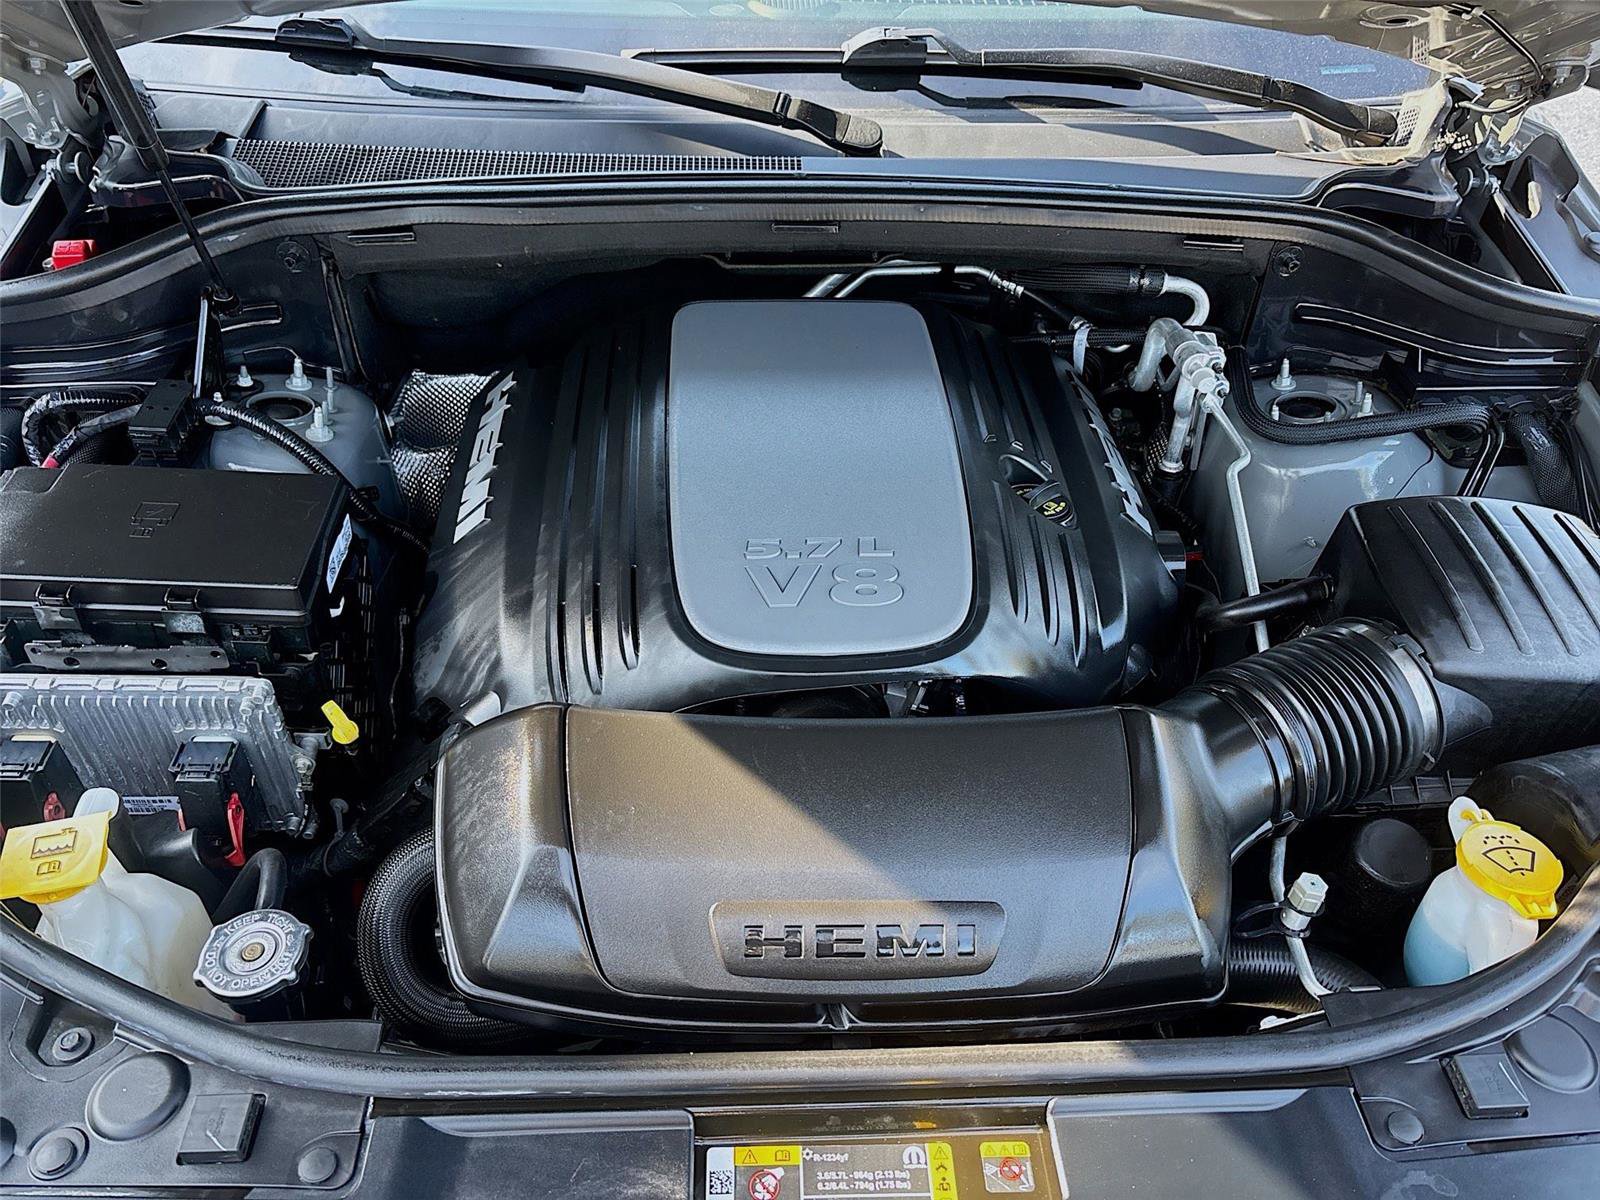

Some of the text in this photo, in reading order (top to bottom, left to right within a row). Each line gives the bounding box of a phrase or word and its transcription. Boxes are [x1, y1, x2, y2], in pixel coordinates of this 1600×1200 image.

[453, 371, 517, 544] HEMI
[743, 563, 905, 608] V8
[223, 913, 296, 936] KEEP TIGHT
[743, 924, 976, 959] HEMI
[205, 951, 216, 968] DO
[207, 967, 231, 986] NOT
[231, 970, 271, 989] OPEN
